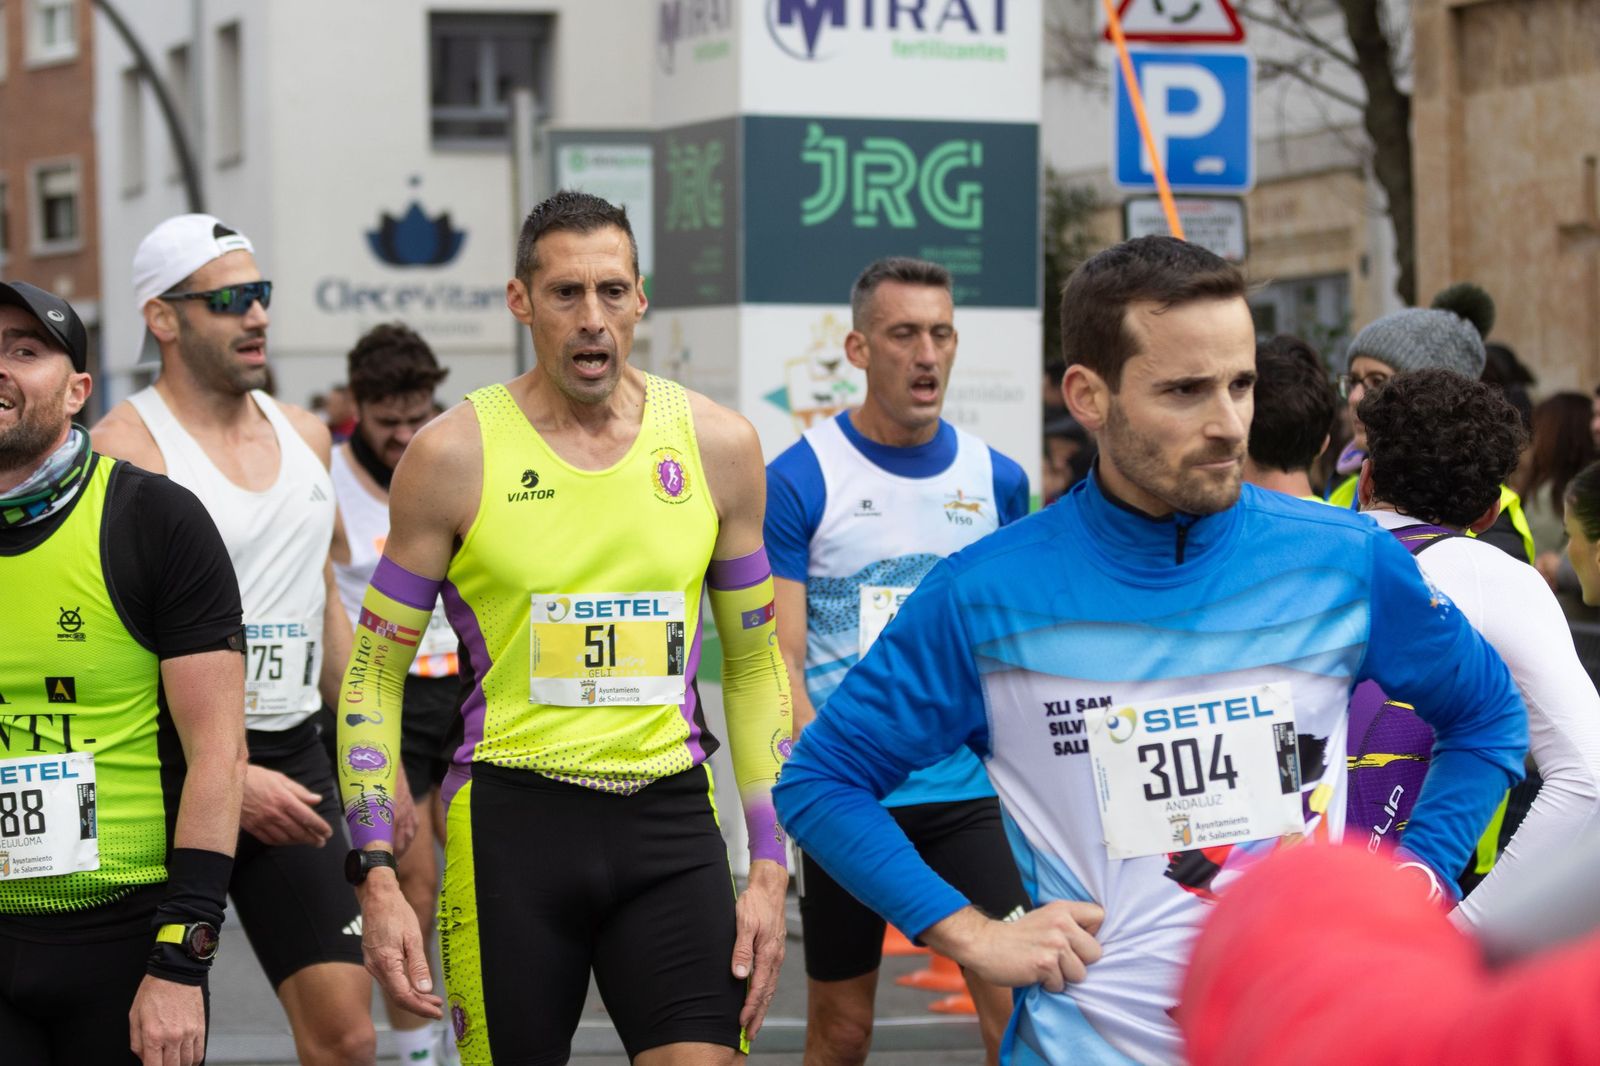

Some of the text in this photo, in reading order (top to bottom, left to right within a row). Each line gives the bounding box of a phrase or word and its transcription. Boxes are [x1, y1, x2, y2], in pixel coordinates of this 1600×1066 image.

[1140, 63, 1225, 174] P
[800, 123, 983, 229] JRG
[507, 489, 555, 502] VIATOR
[945, 510, 973, 526] Viso
[575, 599, 669, 618] SETEL
[245, 624, 308, 639] SETEL
[585, 624, 616, 667] 51
[245, 644, 283, 681] 75
[588, 668, 612, 678] GELI
[598, 687, 640, 695] Ayuntamiento
[607, 695, 640, 703] Salamanca
[1043, 695, 1112, 717] XLI SAN
[1143, 695, 1274, 733] SETEL
[1048, 719, 1087, 736] SILV
[1137, 734, 1238, 801] 304
[1165, 794, 1223, 812] ANDALUZ
[1195, 816, 1249, 831] Ayuntamiento
[1208, 828, 1251, 841] Salamanca
[12, 855, 53, 866] Ayuntamiento
[22, 865, 54, 874] Salamanca
